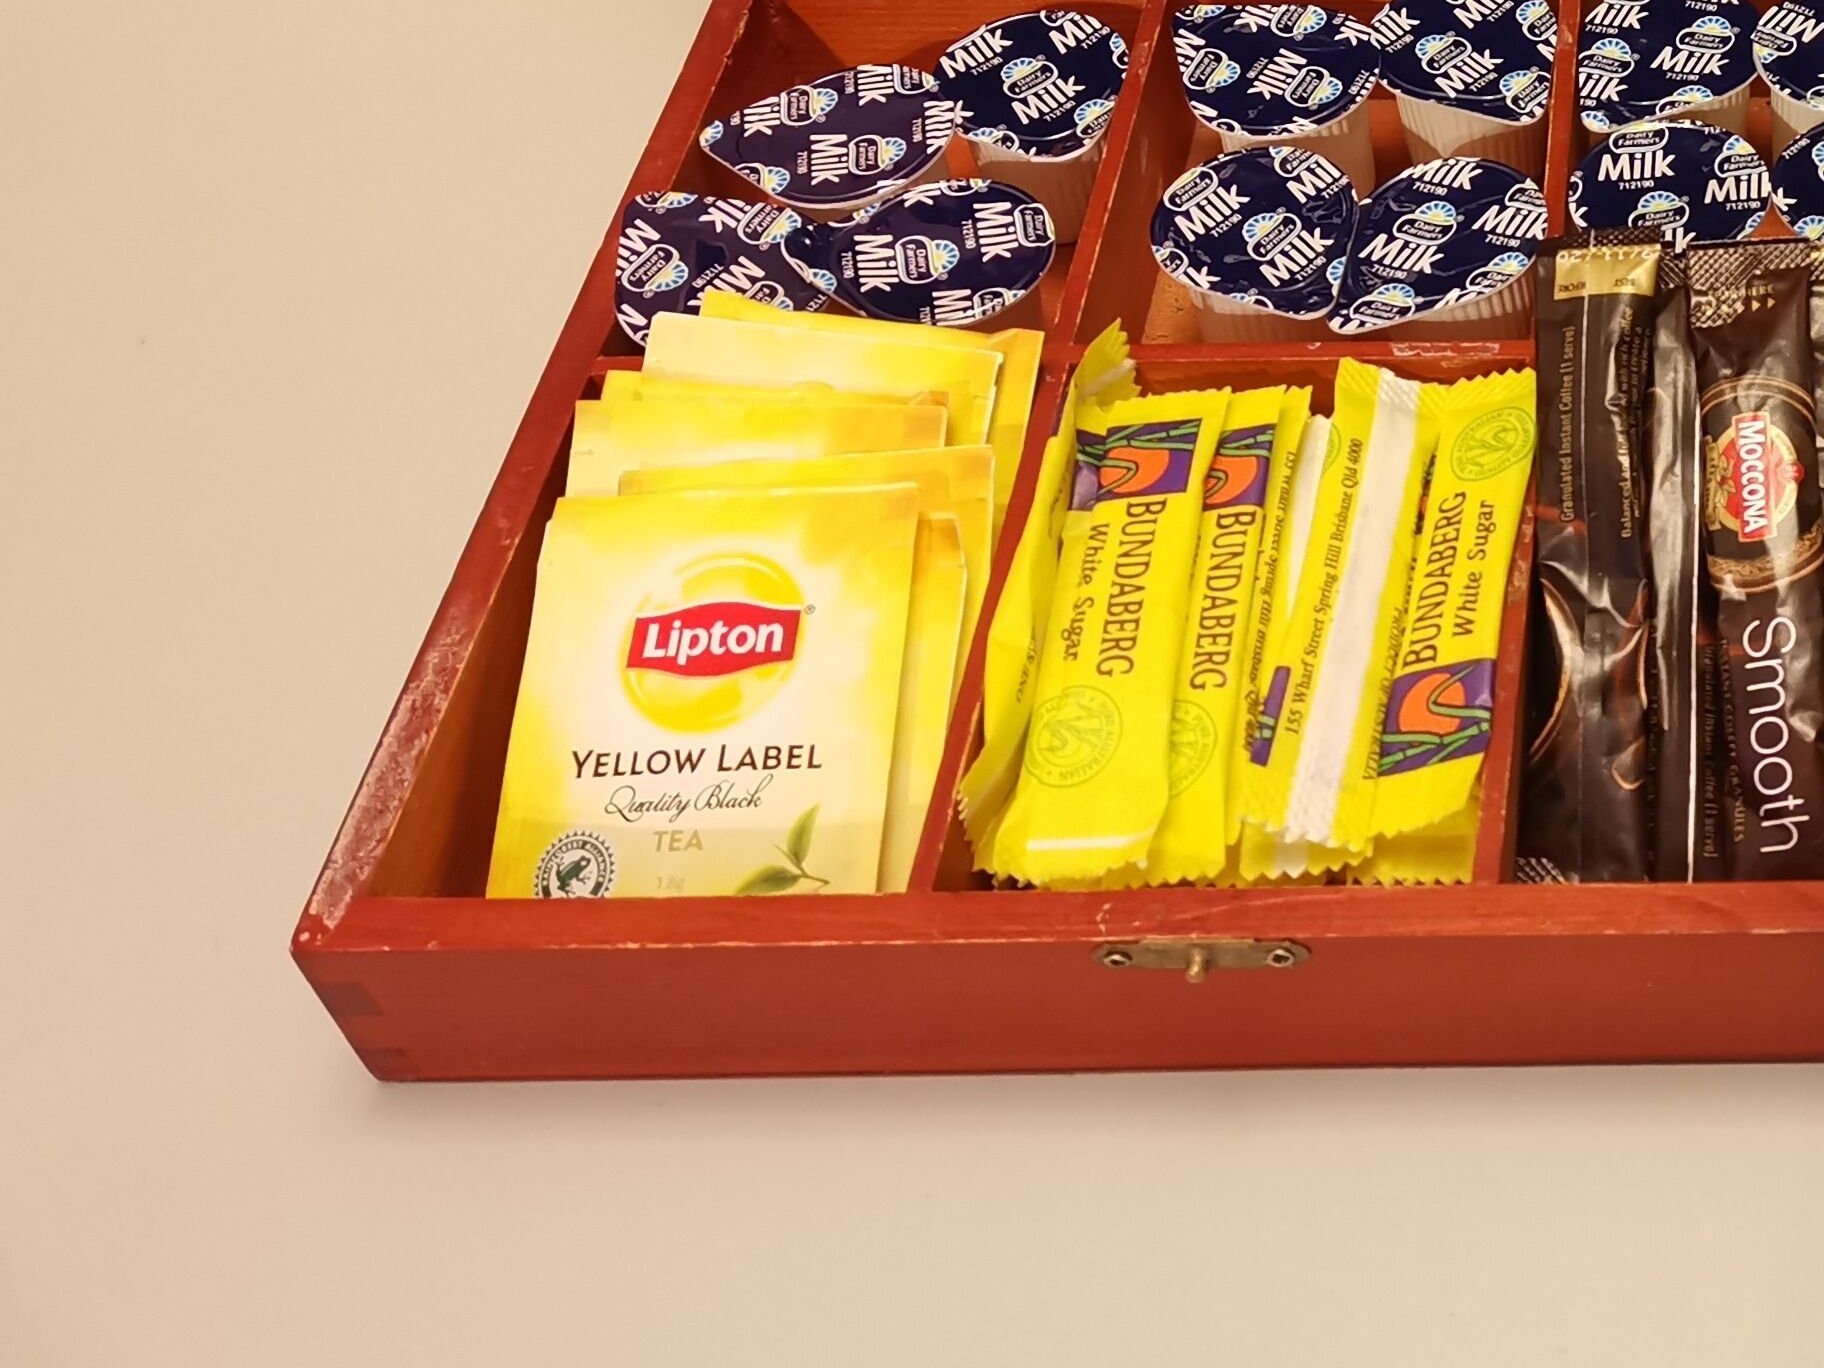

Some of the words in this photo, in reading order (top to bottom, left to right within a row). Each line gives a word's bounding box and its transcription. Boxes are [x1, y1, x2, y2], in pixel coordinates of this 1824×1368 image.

[940, 29, 1013, 78] Milk
[1247, 48, 1308, 100] Milk
[1434, 49, 1504, 98] Milk
[1650, 46, 1730, 76] Milk
[1011, 75, 1086, 125] Milk
[809, 134, 849, 186] Milk
[1597, 150, 1676, 181] Milk
[1618, 135, 1660, 147] Farmers
[973, 202, 1020, 263] Milk
[1174, 184, 1250, 242] Milk
[1402, 224, 1443, 240] Farmers
[1414, 220, 1442, 233] Dairy
[853, 234, 900, 293] Milk
[1259, 227, 1334, 287] Milk
[1358, 233, 1445, 274] Milk
[1560, 325, 1577, 363] serve)
[1558, 375, 1573, 410] Coffee
[1344, 437, 1364, 466] 4000
[1558, 411, 1573, 454] Instant
[1558, 457, 1574, 522] Granulated
[1738, 420, 1769, 534] MOCCONA
[1328, 490, 1353, 543] Brisbane
[1465, 499, 1497, 562] Sugar
[1081, 523, 1110, 586] White
[1323, 543, 1343, 570] Hill
[1096, 497, 1168, 678] BUNDABERG
[1189, 510, 1258, 691] BUNDABERG
[1313, 572, 1339, 616] Spring
[1404, 490, 1467, 669] BUNDABERG
[1450, 569, 1482, 638] White
[643, 619, 784, 666] Lipton
[1061, 596, 1095, 661] Sugar
[1304, 617, 1325, 659] Street
[1290, 660, 1316, 704] Wharf
[1283, 708, 1303, 736] 155
[1362, 695, 1387, 780] AUSTRALIA
[1742, 617, 1810, 853] Smooth
[572, 747, 706, 779] YELLOW
[717, 744, 823, 773] LABEL
[604, 785, 692, 823] Quality
[694, 774, 774, 810] Black
[653, 829, 704, 853] TEA
